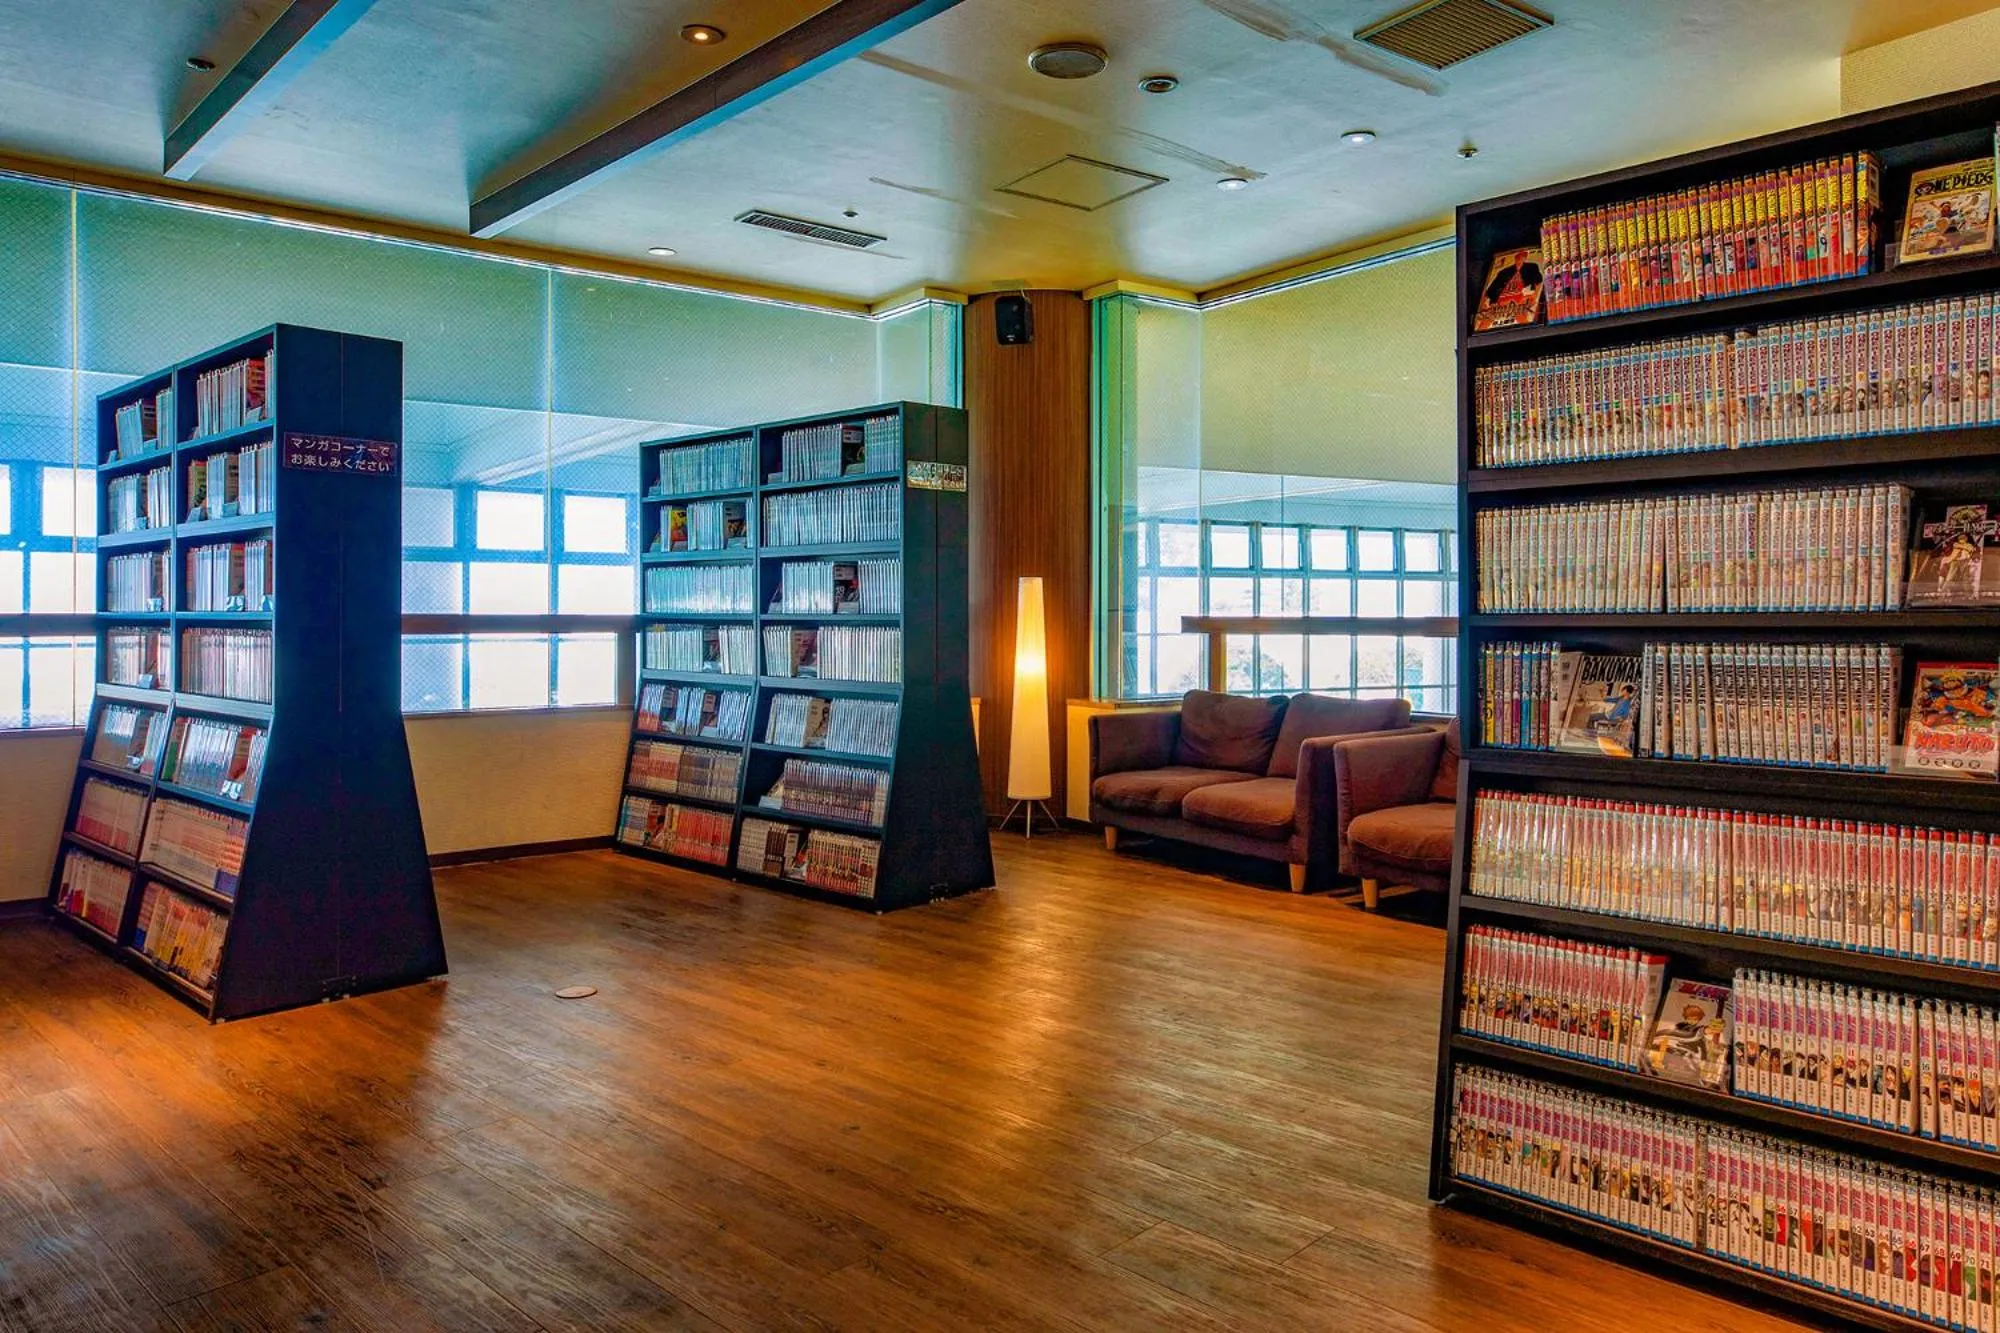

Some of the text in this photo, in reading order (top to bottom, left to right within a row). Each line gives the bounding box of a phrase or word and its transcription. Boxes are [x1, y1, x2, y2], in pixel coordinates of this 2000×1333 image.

[291, 437, 390, 457] マンガコーナーで
[291, 453, 390, 472] お楽しみください
